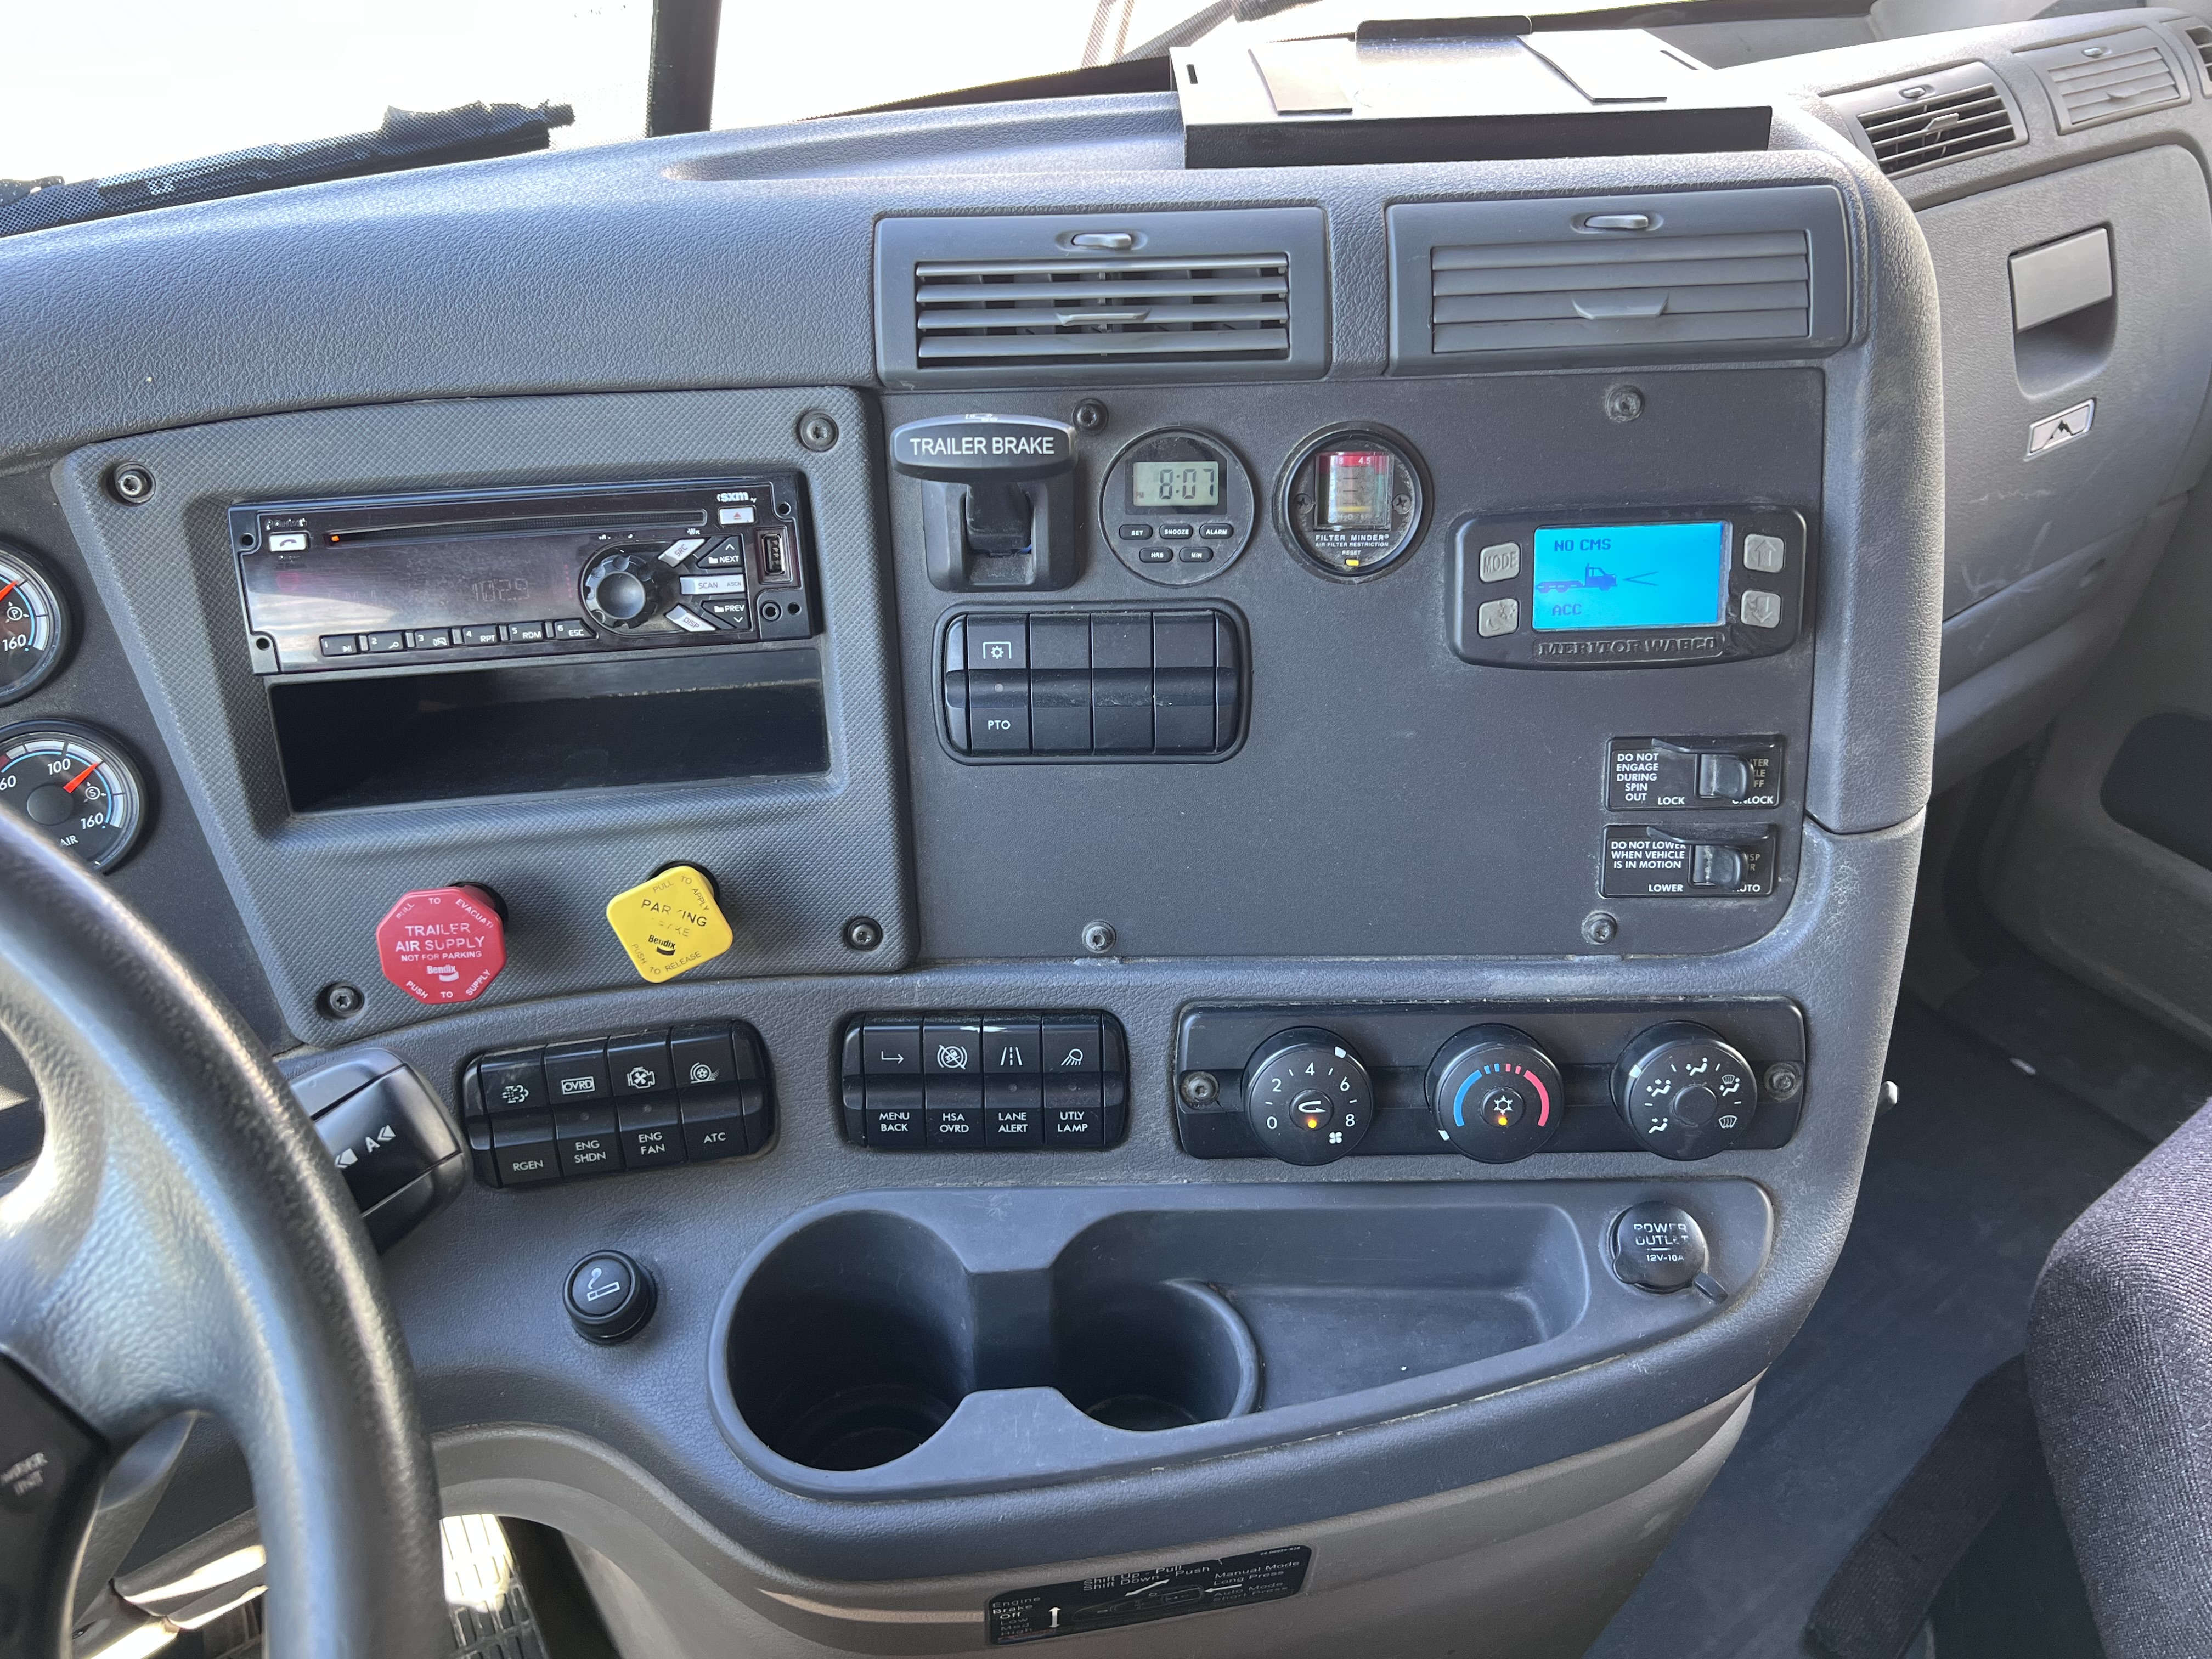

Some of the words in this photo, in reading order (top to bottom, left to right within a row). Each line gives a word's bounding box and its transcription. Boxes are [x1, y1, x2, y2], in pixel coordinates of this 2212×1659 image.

[910, 437, 988, 455] TRAILER
[992, 436, 1054, 455] BRAKE
[1159, 469, 1215, 499] 8:07
[674, 544, 688, 557] SRC
[1554, 539, 1575, 551] NO
[1580, 538, 1611, 551] CMS
[1483, 551, 1518, 574] MODE
[1552, 603, 1582, 616] ACC
[682, 617, 699, 628] DISP
[2, 634, 26, 651] 160
[1538, 639, 1642, 656] MERITOR
[988, 720, 1011, 730] PTO
[1617, 753, 1633, 761] DO
[1636, 753, 1658, 761] NOT
[47, 758, 71, 775] 100
[1616, 763, 1658, 771] ENGAGE
[1617, 773, 1657, 781] DURING
[1625, 783, 1647, 791] SPIN
[1625, 793, 1647, 801] OUT
[1657, 797, 1685, 805] LOCK
[81, 812, 104, 830] 160
[60, 835, 79, 847] AIR
[1611, 841, 1627, 849] DO
[1628, 841, 1650, 849] NOT
[652, 880, 674, 893] PULL
[681, 876, 692, 884] TO
[692, 888, 709, 912] APPLY
[1648, 884, 1683, 892] LOWER
[1732, 884, 1760, 892] UTO
[641, 899, 707, 927] PARING
[405, 922, 471, 936] TRAILER
[395, 940, 421, 952] AIR
[425, 936, 485, 951] SUPPLY
[648, 934, 676, 949] Bendix
[442, 950, 482, 959] PARKING
[632, 943, 647, 964] PUSH
[649, 967, 661, 975] TO
[664, 951, 702, 972] RELEASE
[427, 964, 456, 974] Bendix
[406, 980, 428, 999] PUSH
[465, 969, 491, 996] SUPPLY
[1305, 1062, 1315, 1076] 4
[563, 1079, 593, 1091] OVRD
[1272, 1078, 1282, 1092] 2
[1340, 1076, 1350, 1091] 6
[879, 1112, 910, 1120] MENU
[943, 1113, 965, 1121] HSA
[998, 1112, 1027, 1121] LANE
[1060, 1111, 1085, 1120] UTLY
[1345, 1114, 1355, 1127] 8
[881, 1124, 909, 1132] BACK
[939, 1124, 969, 1133] OVRD
[998, 1124, 1028, 1132] ALERT
[1057, 1124, 1088, 1132] LAMP
[1266, 1116, 1278, 1130] 0
[638, 1132, 663, 1143] ENG
[704, 1132, 726, 1144] ATC
[365, 1136, 380, 1153] A
[575, 1140, 600, 1151] ENG
[640, 1143, 665, 1155] FAN
[574, 1152, 606, 1164] SHDN
[512, 1160, 544, 1172] RGEN
[1084, 1576, 1115, 1585] Shift
[1155, 1565, 1181, 1574] Pull
[1215, 1566, 1261, 1578] Manual
[1265, 1561, 1300, 1570] Mode
[1084, 1582, 1115, 1591] Shift
[1120, 1575, 1159, 1585] Down
[1175, 1566, 1210, 1576] Push
[1214, 1577, 1244, 1585] Long
[1249, 1570, 1284, 1579] Press
[1248, 1582, 1284, 1590] Mode
[992, 1597, 1041, 1608] Engine
[993, 1605, 1032, 1614] Brake
[1001, 1622, 1029, 1631] Med
